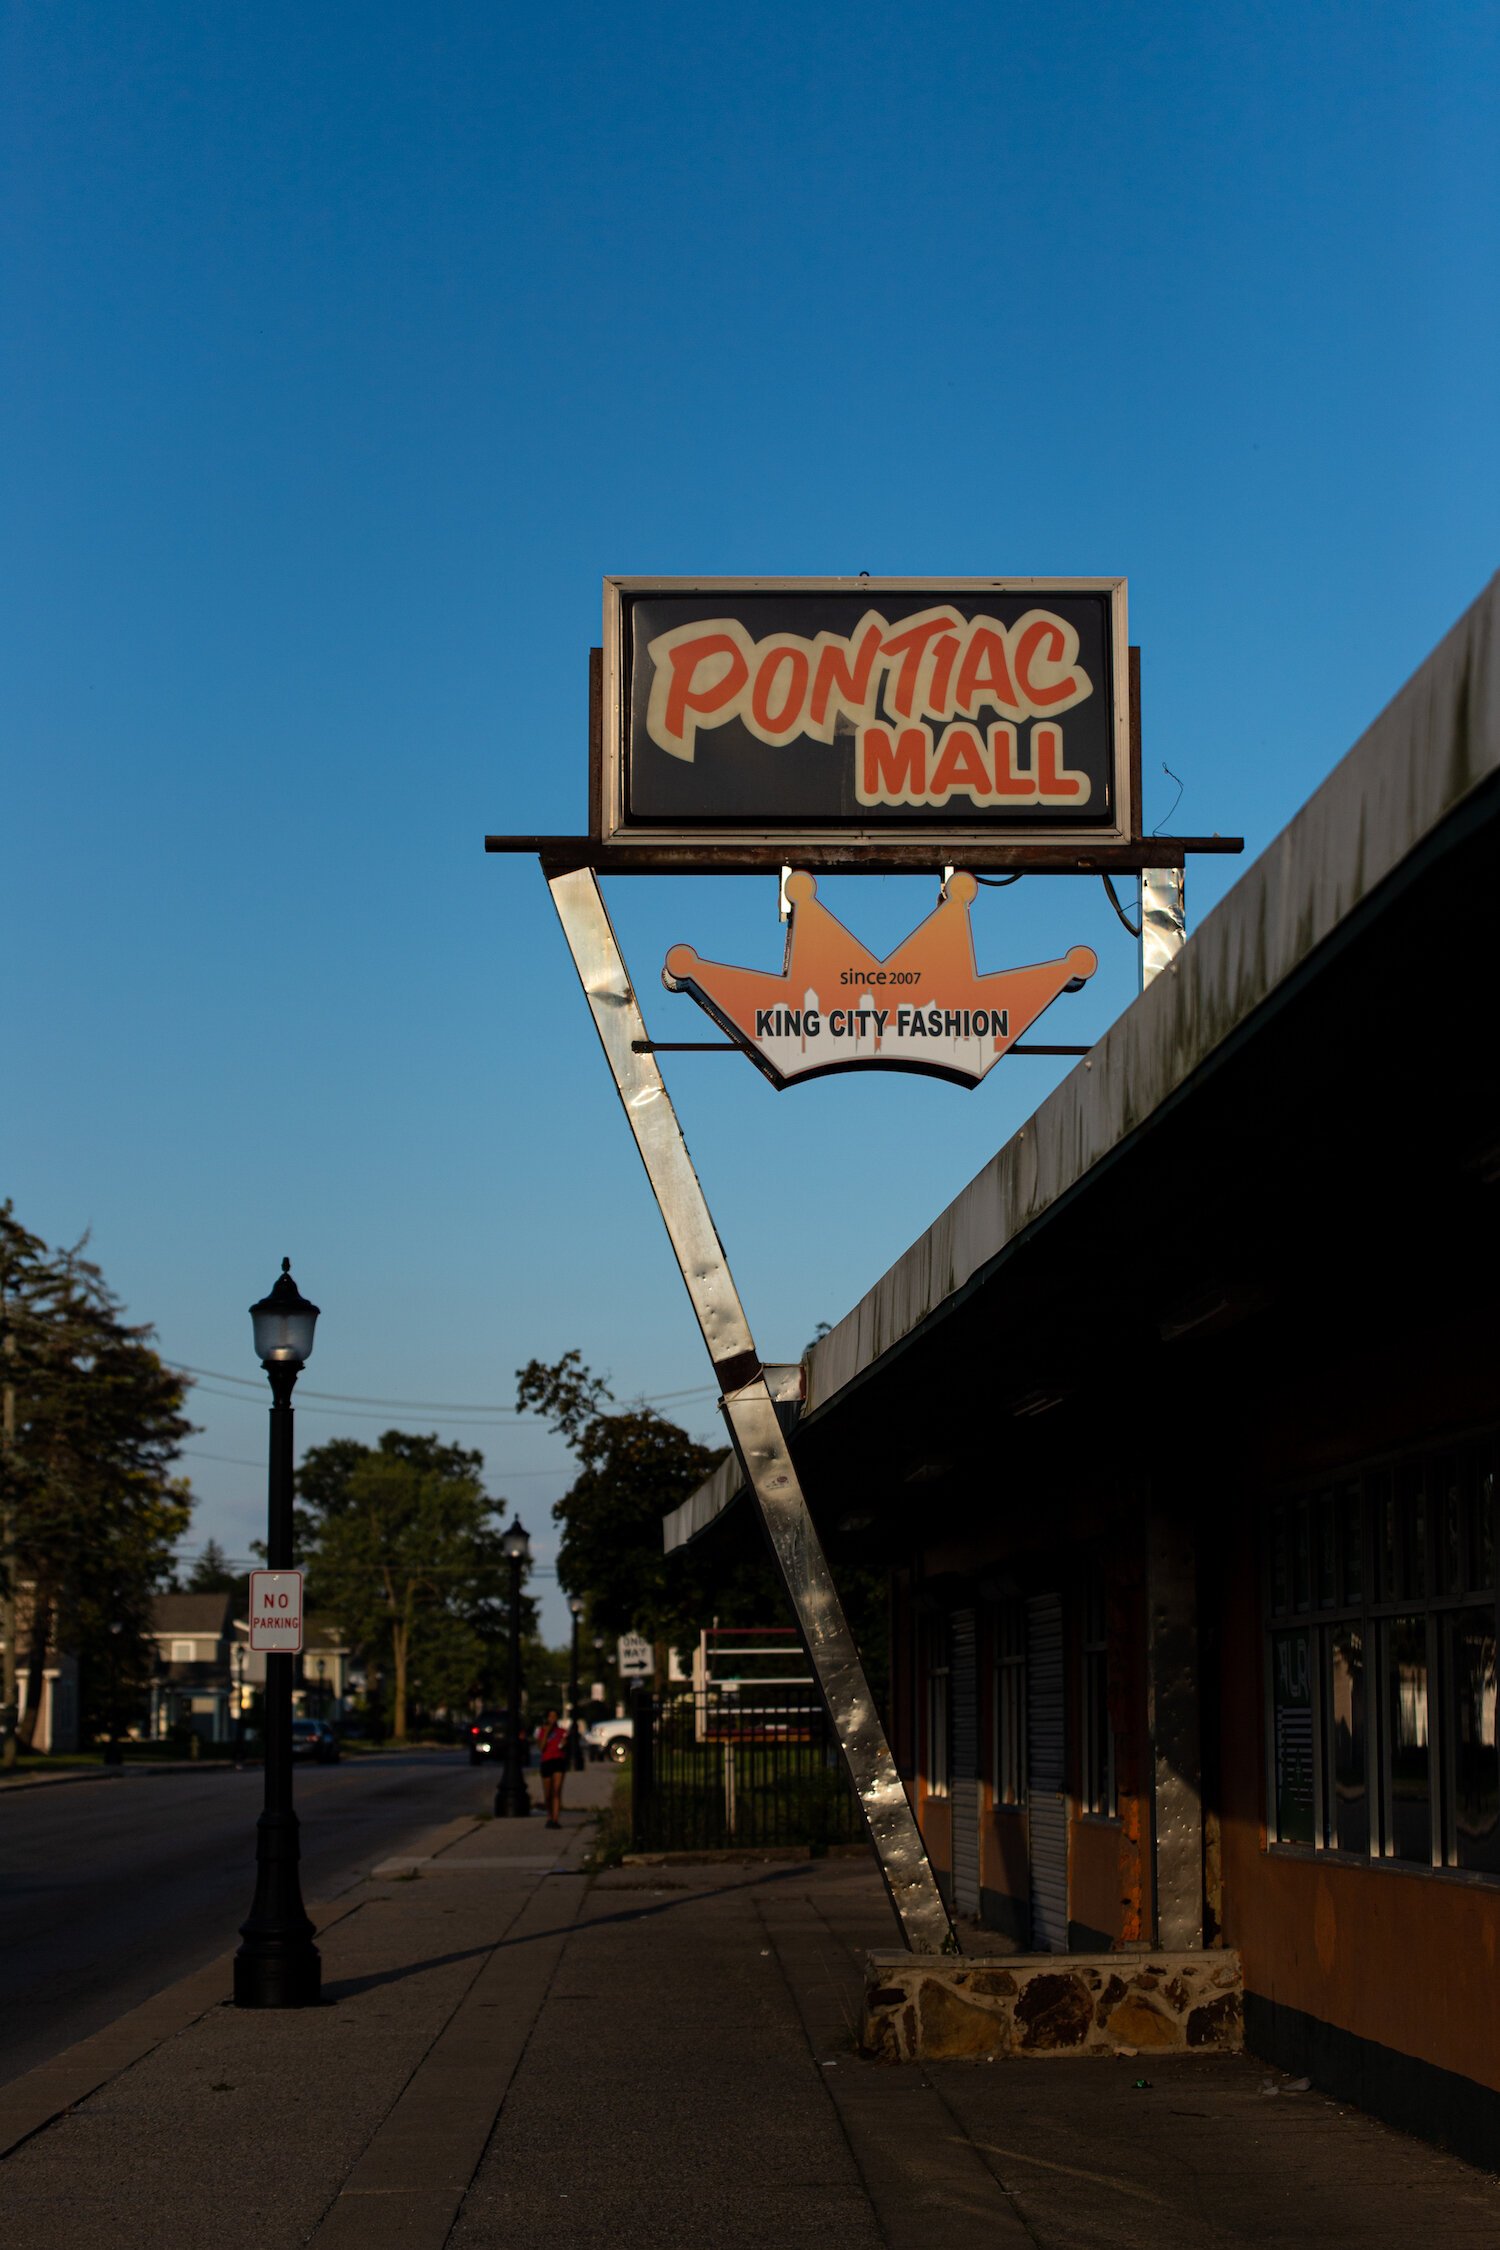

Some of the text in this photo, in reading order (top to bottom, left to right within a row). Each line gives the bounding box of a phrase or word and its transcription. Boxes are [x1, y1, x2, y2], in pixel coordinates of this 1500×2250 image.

[663, 615, 1080, 741] PONTIAC
[861, 726, 1082, 797] MALL
[839, 968, 922, 985] since 2007
[755, 1009, 1009, 1038] KING CITY FASHION
[264, 1593, 289, 1609] NO
[253, 1617, 299, 1629] PARKING
[623, 1647, 647, 1659] WAY
